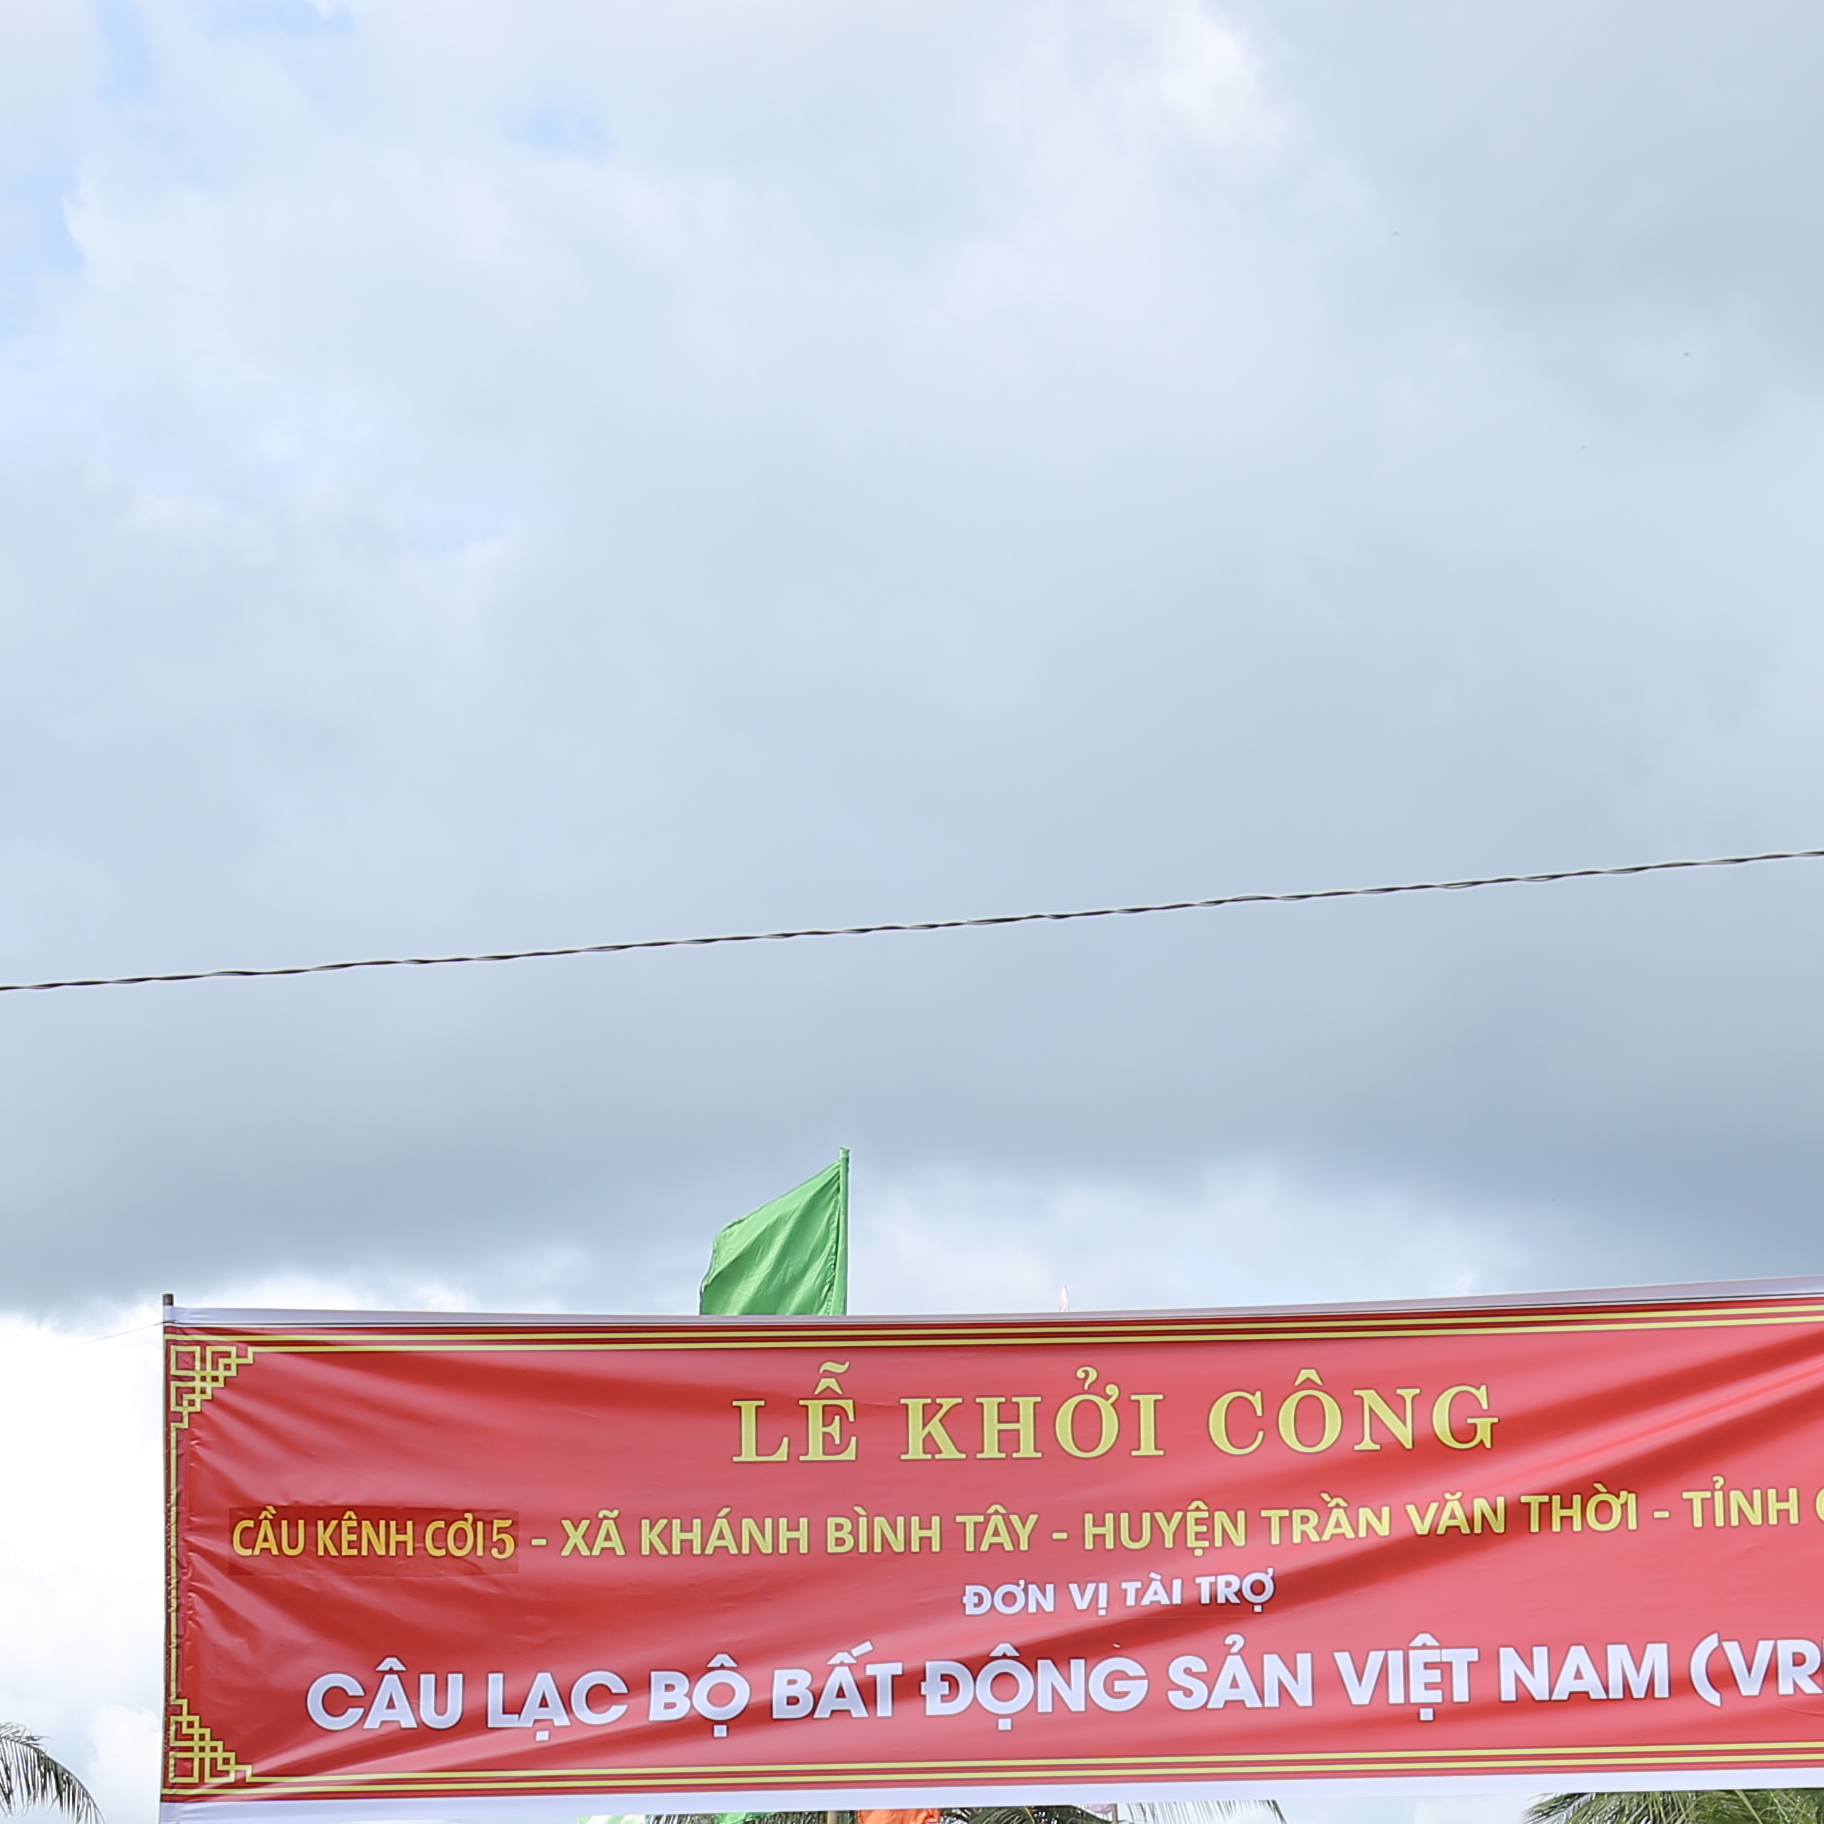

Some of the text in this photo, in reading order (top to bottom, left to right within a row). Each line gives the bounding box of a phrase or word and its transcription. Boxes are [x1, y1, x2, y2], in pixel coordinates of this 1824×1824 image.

[732, 1361, 1499, 1462] LỄ KHỞI CÔNG
[233, 1506, 304, 1556] CẦU
[317, 1511, 413, 1556] KÊNH
[560, 1509, 626, 1556] XÃ
[641, 1507, 808, 1555] KHÁNH
[827, 1506, 941, 1553] BÌNH
[955, 1504, 1039, 1552] TÂY
[1084, 1500, 1246, 1557] HUYỆN
[1260, 1493, 1389, 1545] TRẦN
[1405, 1491, 1505, 1535] VĂN
[1520, 1483, 1638, 1533] THỜI
[1682, 1475, 1799, 1528] TỈNH
[962, 1567, 1274, 1616] ĐƠN VỊ TÀI TRỢ
[307, 1657, 463, 1731] CÂU
[487, 1670, 628, 1742] LẠC
[648, 1653, 751, 1738] BỘ
[772, 1640, 903, 1719] BẤT
[920, 1642, 1149, 1731] ĐỘNG
[1167, 1633, 1313, 1710] SẢN
[1333, 1633, 1479, 1721] VIỆT
[1499, 1643, 1669, 1702] NAM
